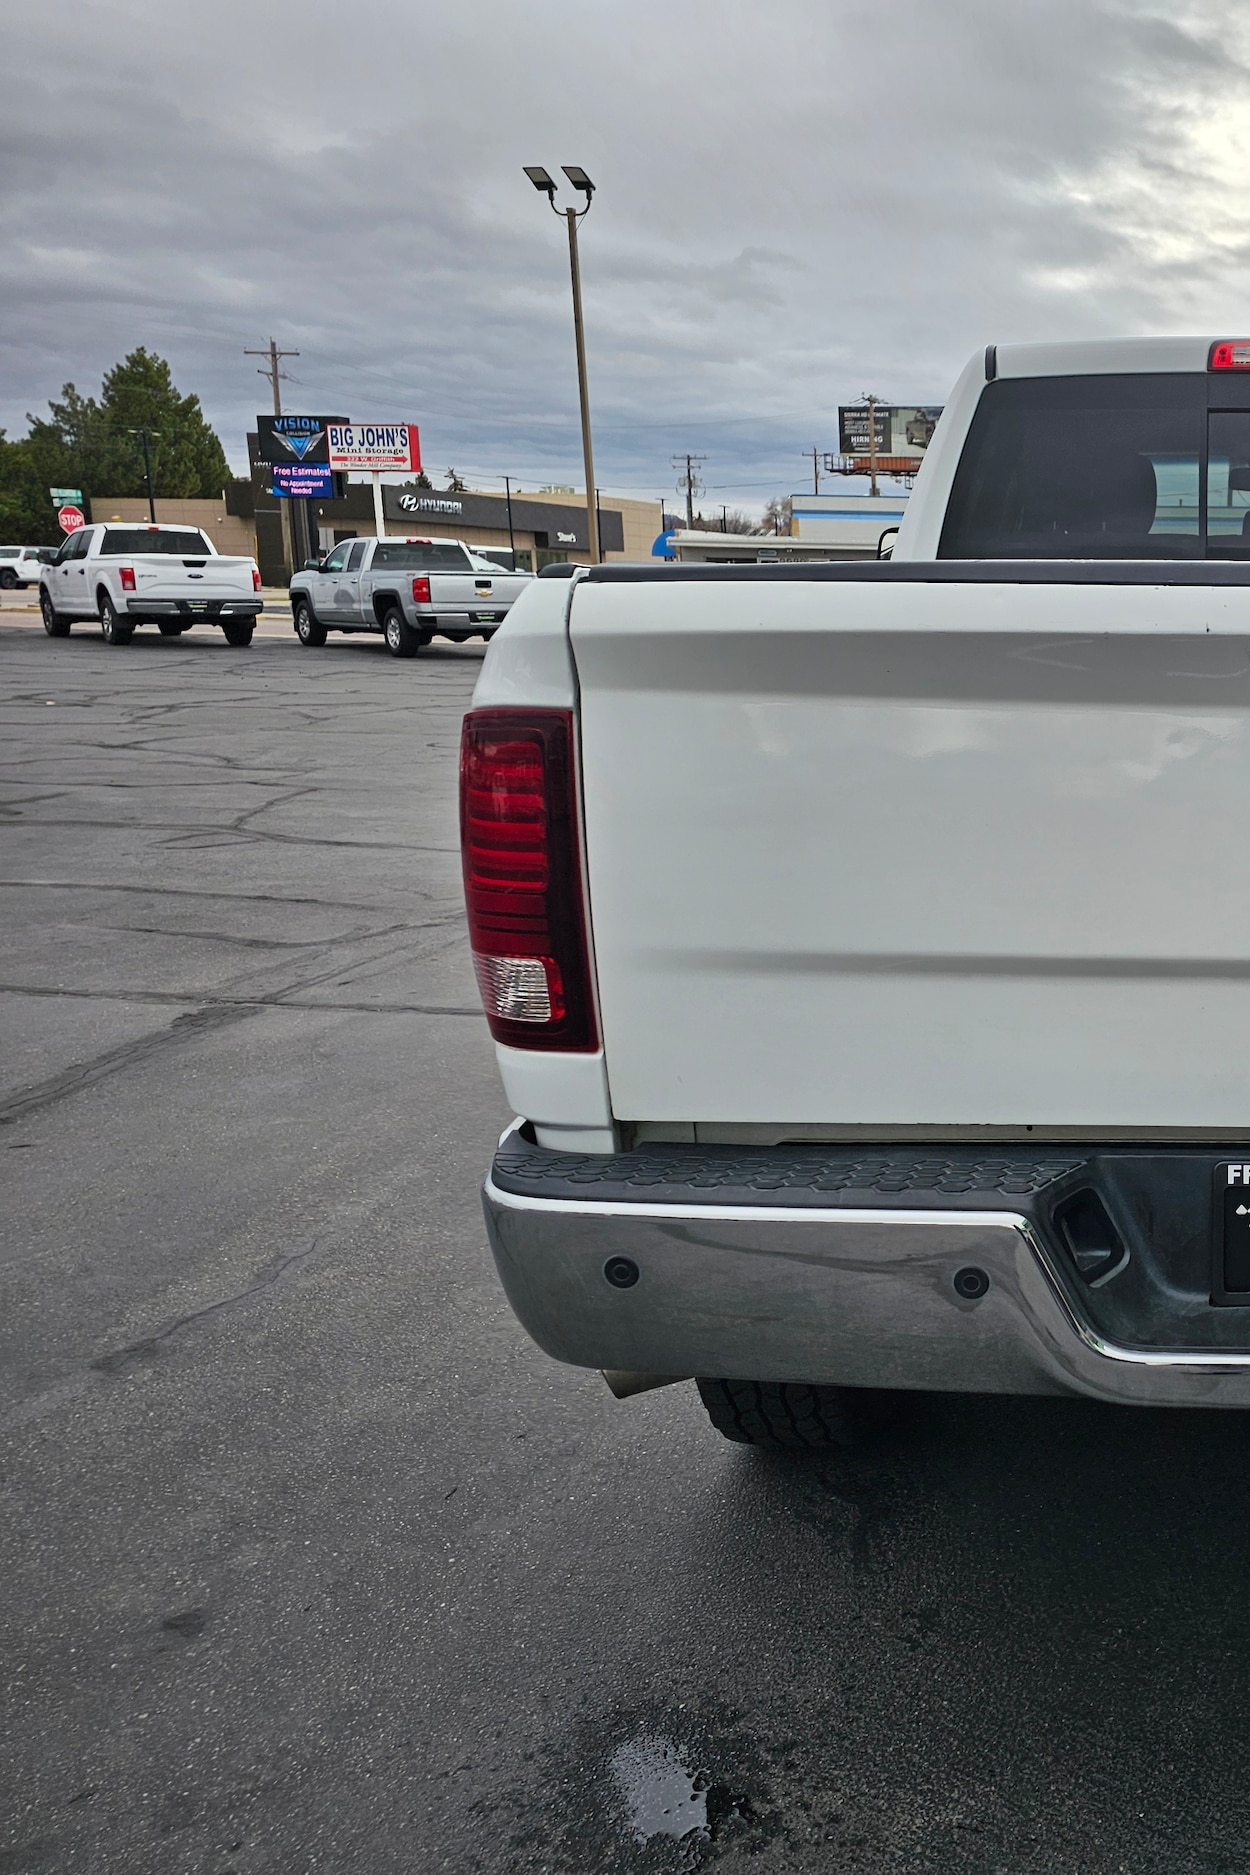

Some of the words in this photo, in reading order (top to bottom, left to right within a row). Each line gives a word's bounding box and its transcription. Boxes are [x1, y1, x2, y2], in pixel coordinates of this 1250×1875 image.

[274, 417, 320, 432] VISION
[330, 427, 354, 446] BIG
[358, 427, 408, 447] JOHN'S
[851, 435, 883, 444] HIRNNG
[365, 447, 404, 455] Storage
[273, 466, 291, 476] Free
[292, 467, 331, 476] Estimates!
[419, 498, 463, 515] HYUNDAI
[60, 514, 82, 526] STOP
